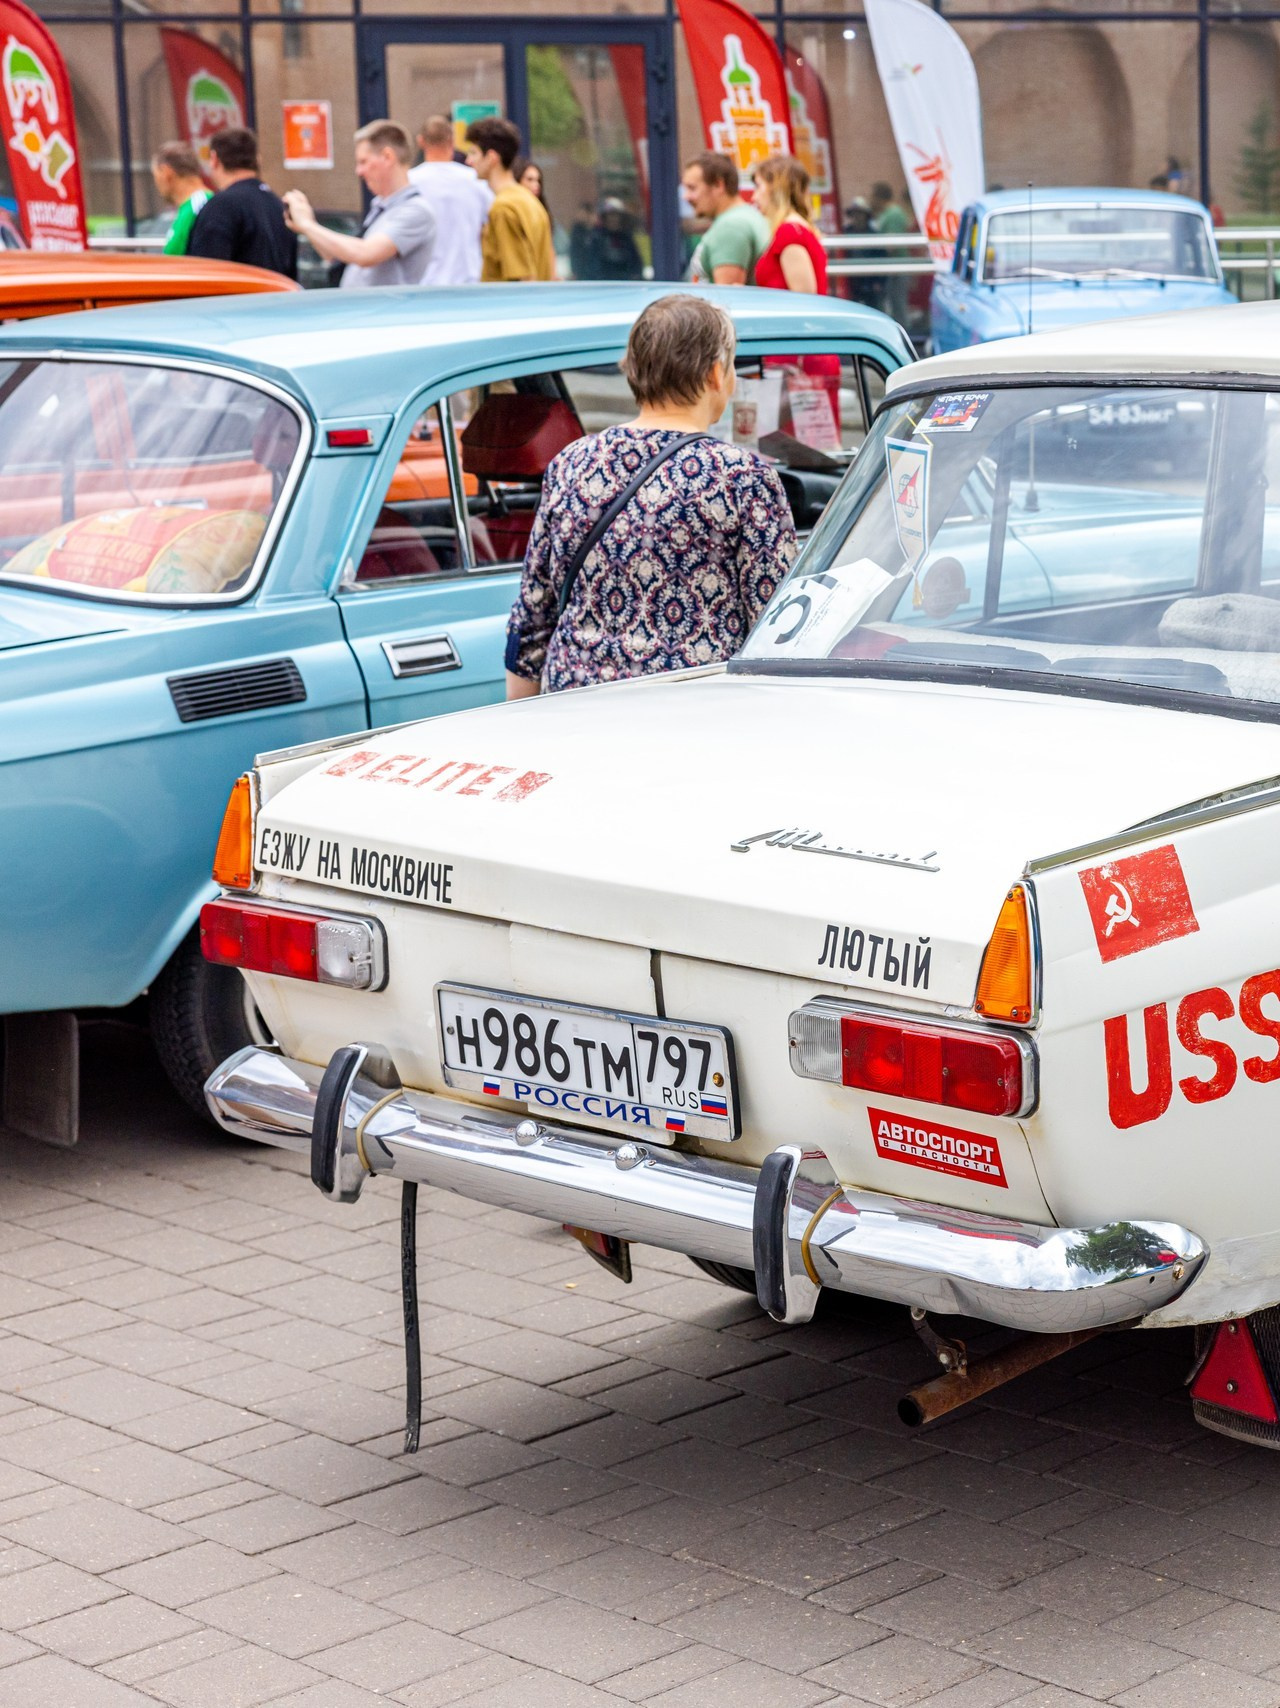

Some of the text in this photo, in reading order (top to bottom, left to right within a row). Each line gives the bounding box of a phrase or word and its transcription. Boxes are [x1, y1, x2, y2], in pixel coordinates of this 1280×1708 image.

[259, 828, 454, 904] ЕЗЖУ НА МОСКВИЧЕ
[817, 924, 932, 990] ЛЮТЫЙ
[637, 1031, 712, 1092] 797
[514, 1082, 651, 1126] РОССИЯ
[663, 1086, 699, 1110] RUS
[877, 1120, 994, 1163] АВТОСПОРТ
[883, 1139, 890, 1148] В
[900, 1144, 991, 1173] ОПАСНОСТИ
